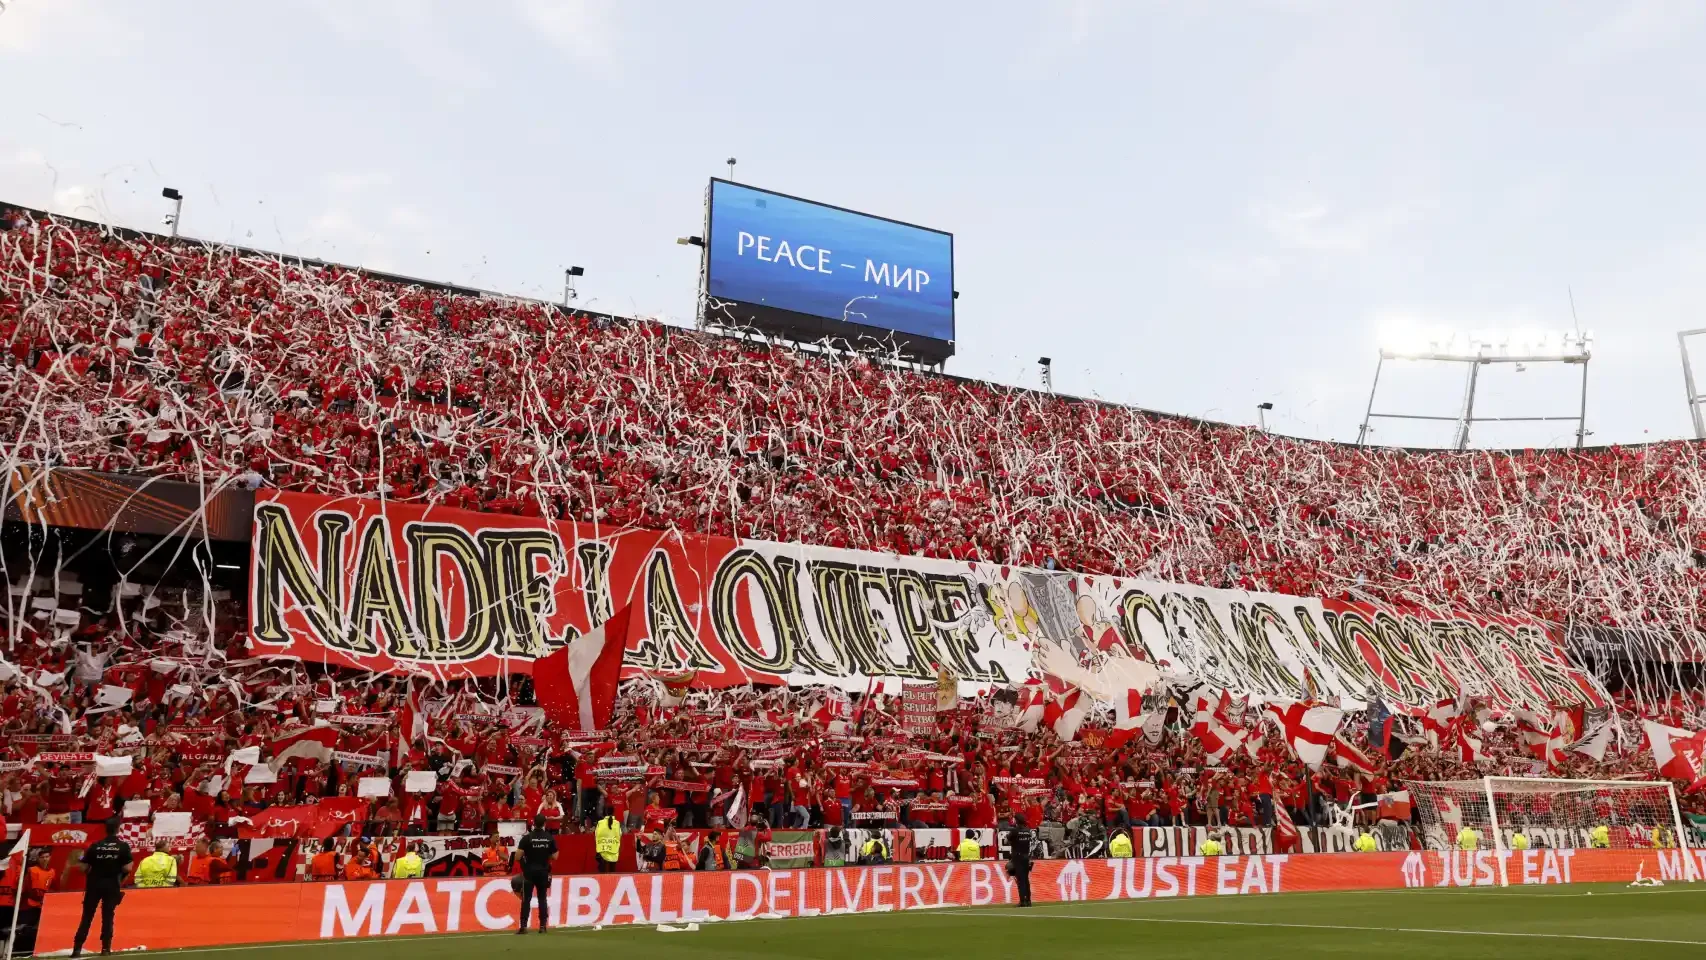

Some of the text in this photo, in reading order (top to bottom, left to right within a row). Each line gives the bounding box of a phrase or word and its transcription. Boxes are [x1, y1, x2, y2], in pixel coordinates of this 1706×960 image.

[738, 231, 832, 274] PEACE
[864, 259, 930, 293] МИР
[253, 503, 585, 662] NADIE
[577, 540, 725, 674] LA
[711, 548, 1009, 682] QUIERE
[904, 714, 935, 723] FUTBO
[181, 753, 223, 761] ALGABA
[994, 776, 1017, 784] BIRIS
[766, 844, 811, 858] ERRERA
[1436, 849, 1575, 886] JUST EAT
[1107, 853, 1288, 898] JUST EAT
[320, 863, 1015, 938] MATCHBALL DELIVERY BY
